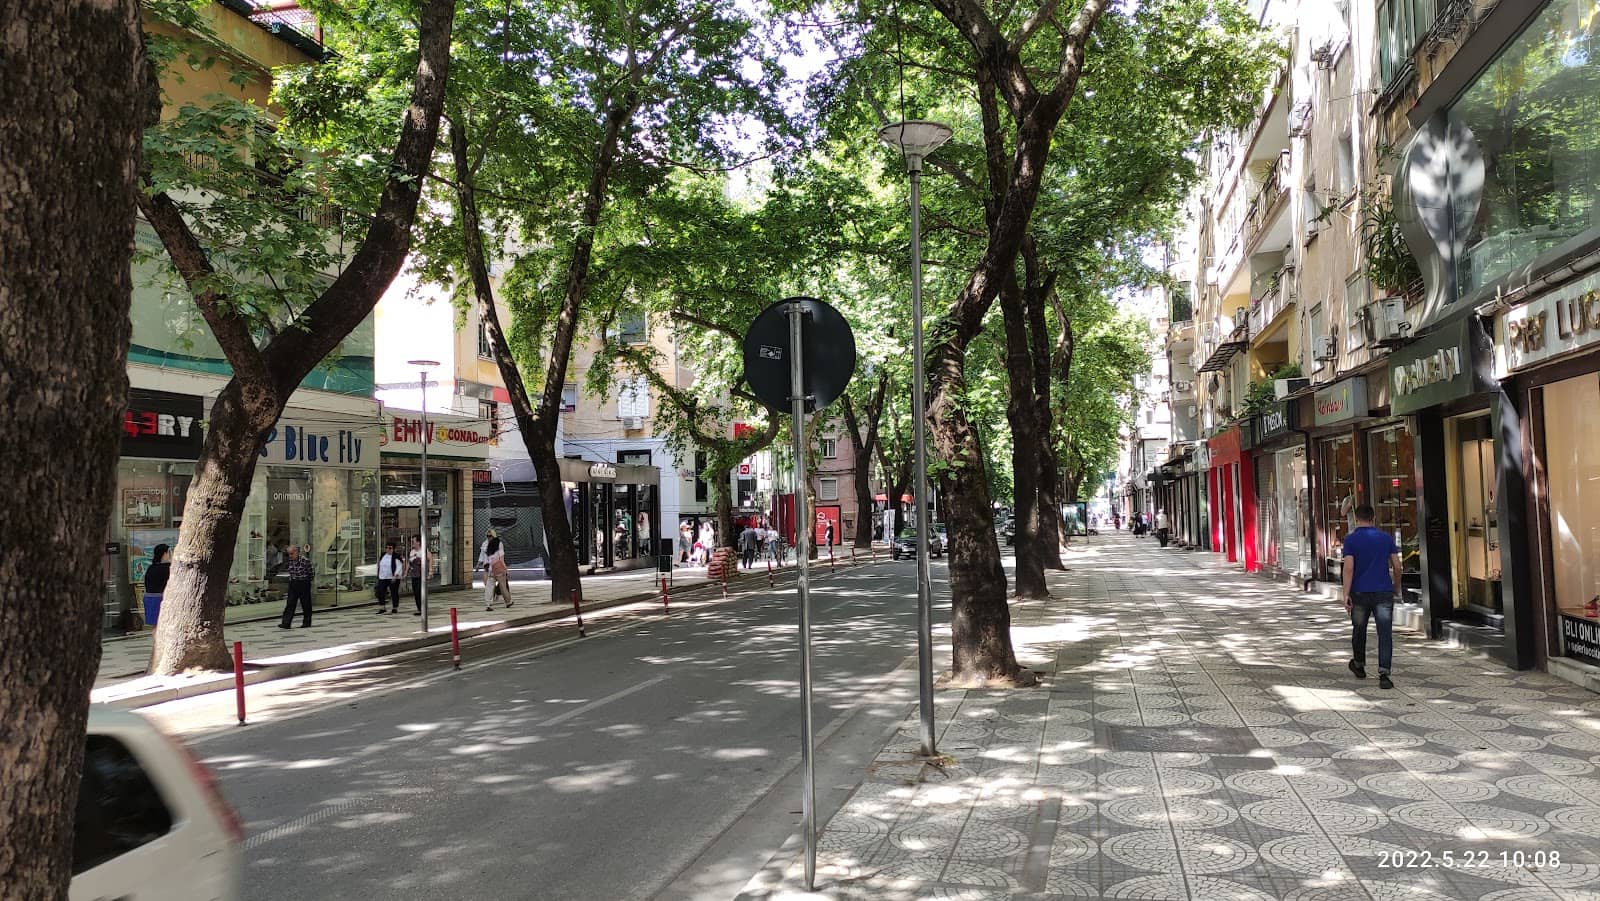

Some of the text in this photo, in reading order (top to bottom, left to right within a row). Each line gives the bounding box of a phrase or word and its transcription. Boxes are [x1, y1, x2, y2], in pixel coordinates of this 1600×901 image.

[285, 425, 329, 462] Blue
[339, 430, 361, 463] Fly
[448, 429, 478, 443] CONAD
[1564, 619, 1600, 645] BLI ONLI
